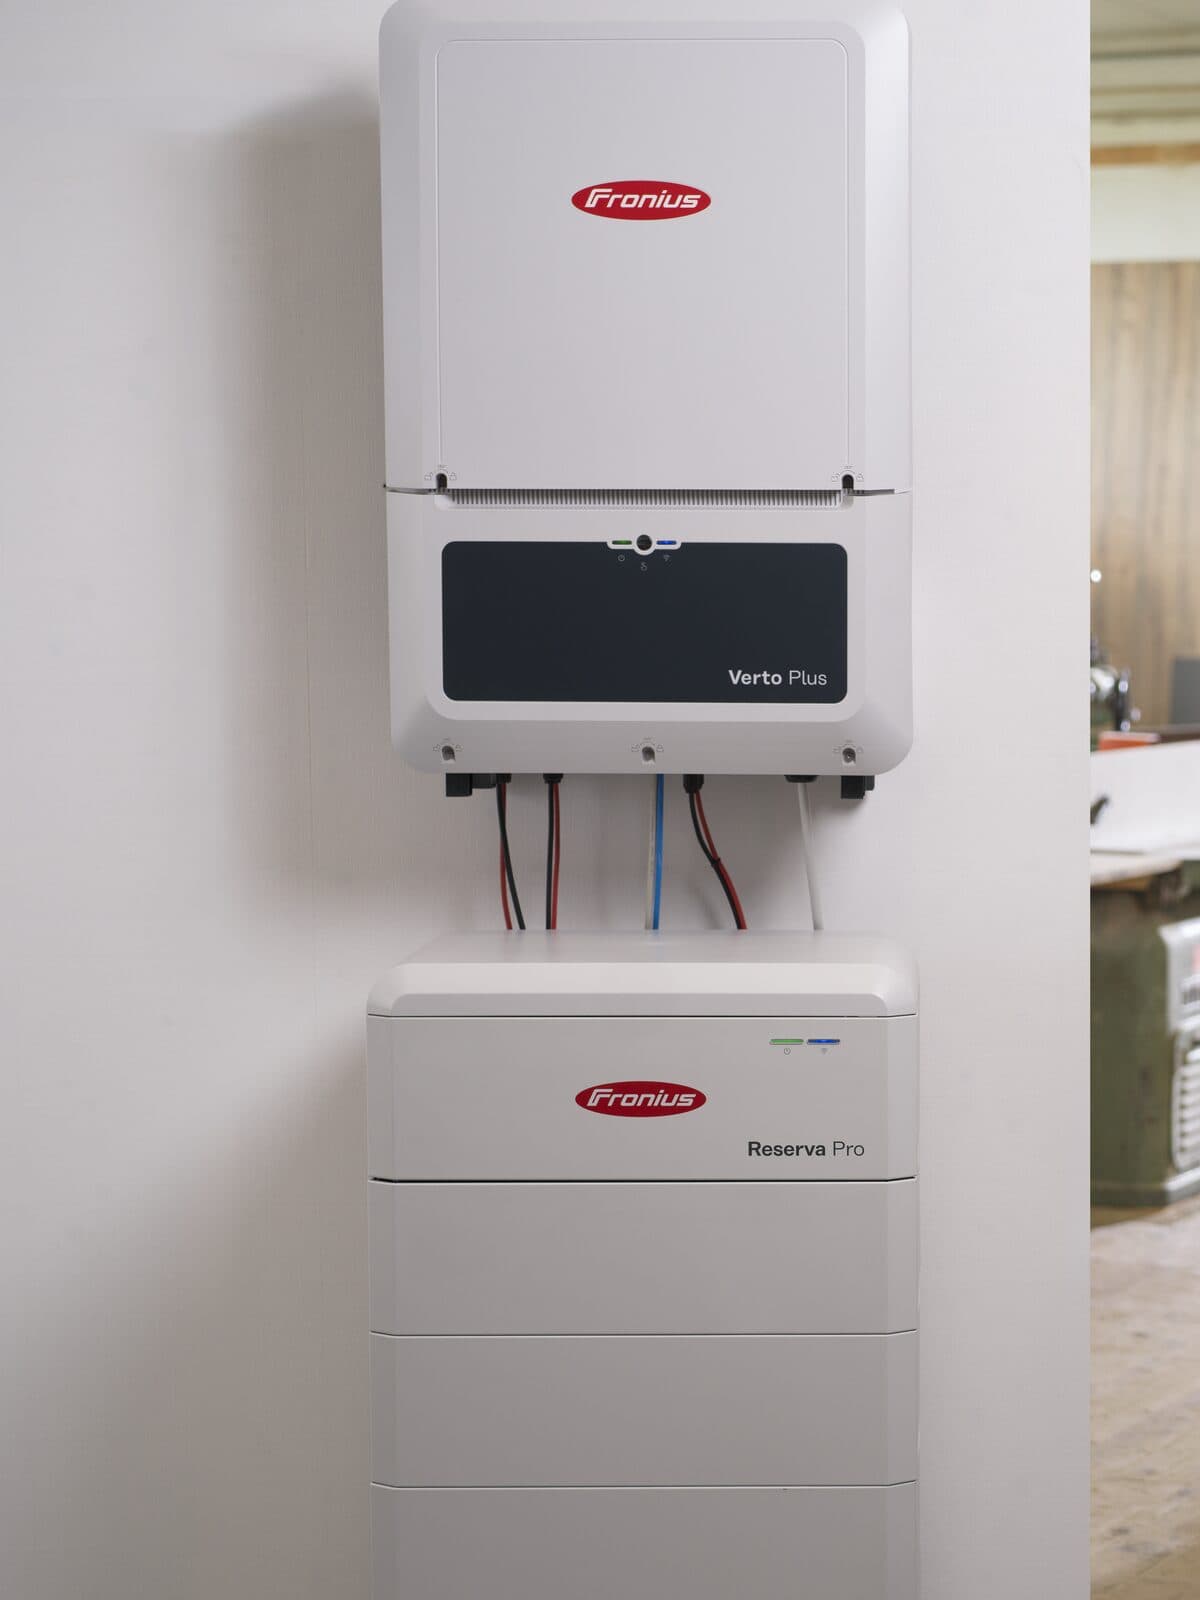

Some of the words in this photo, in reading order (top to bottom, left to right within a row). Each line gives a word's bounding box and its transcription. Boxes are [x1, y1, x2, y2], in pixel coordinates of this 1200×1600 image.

[584, 187, 702, 208] Fronius
[728, 669, 783, 686] Verto
[788, 669, 828, 686] Plus
[586, 1087, 697, 1107] Fronius
[747, 1140, 826, 1157] Reserva
[832, 1140, 865, 1157] Pro
